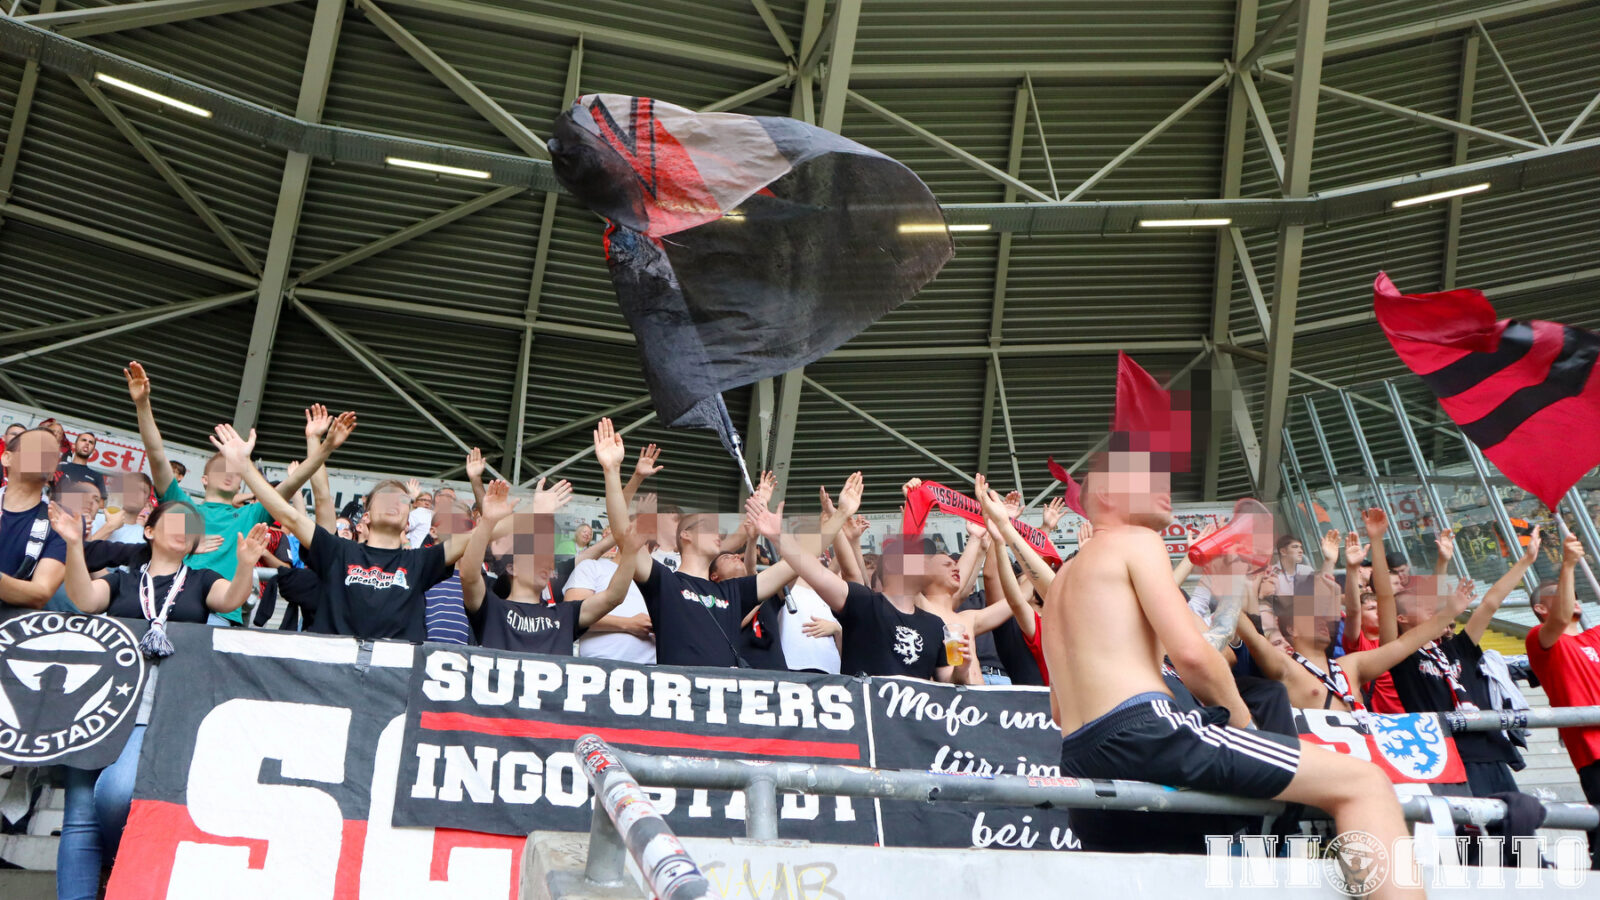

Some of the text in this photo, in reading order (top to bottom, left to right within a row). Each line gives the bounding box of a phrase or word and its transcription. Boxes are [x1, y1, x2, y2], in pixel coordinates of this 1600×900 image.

[19, 614, 137, 667] KOGNITO
[421, 650, 856, 732] SUPPORTERS
[878, 681, 1062, 736] Mofo un
[0, 700, 119, 753] OLSTADT
[971, 811, 1040, 849] bei
